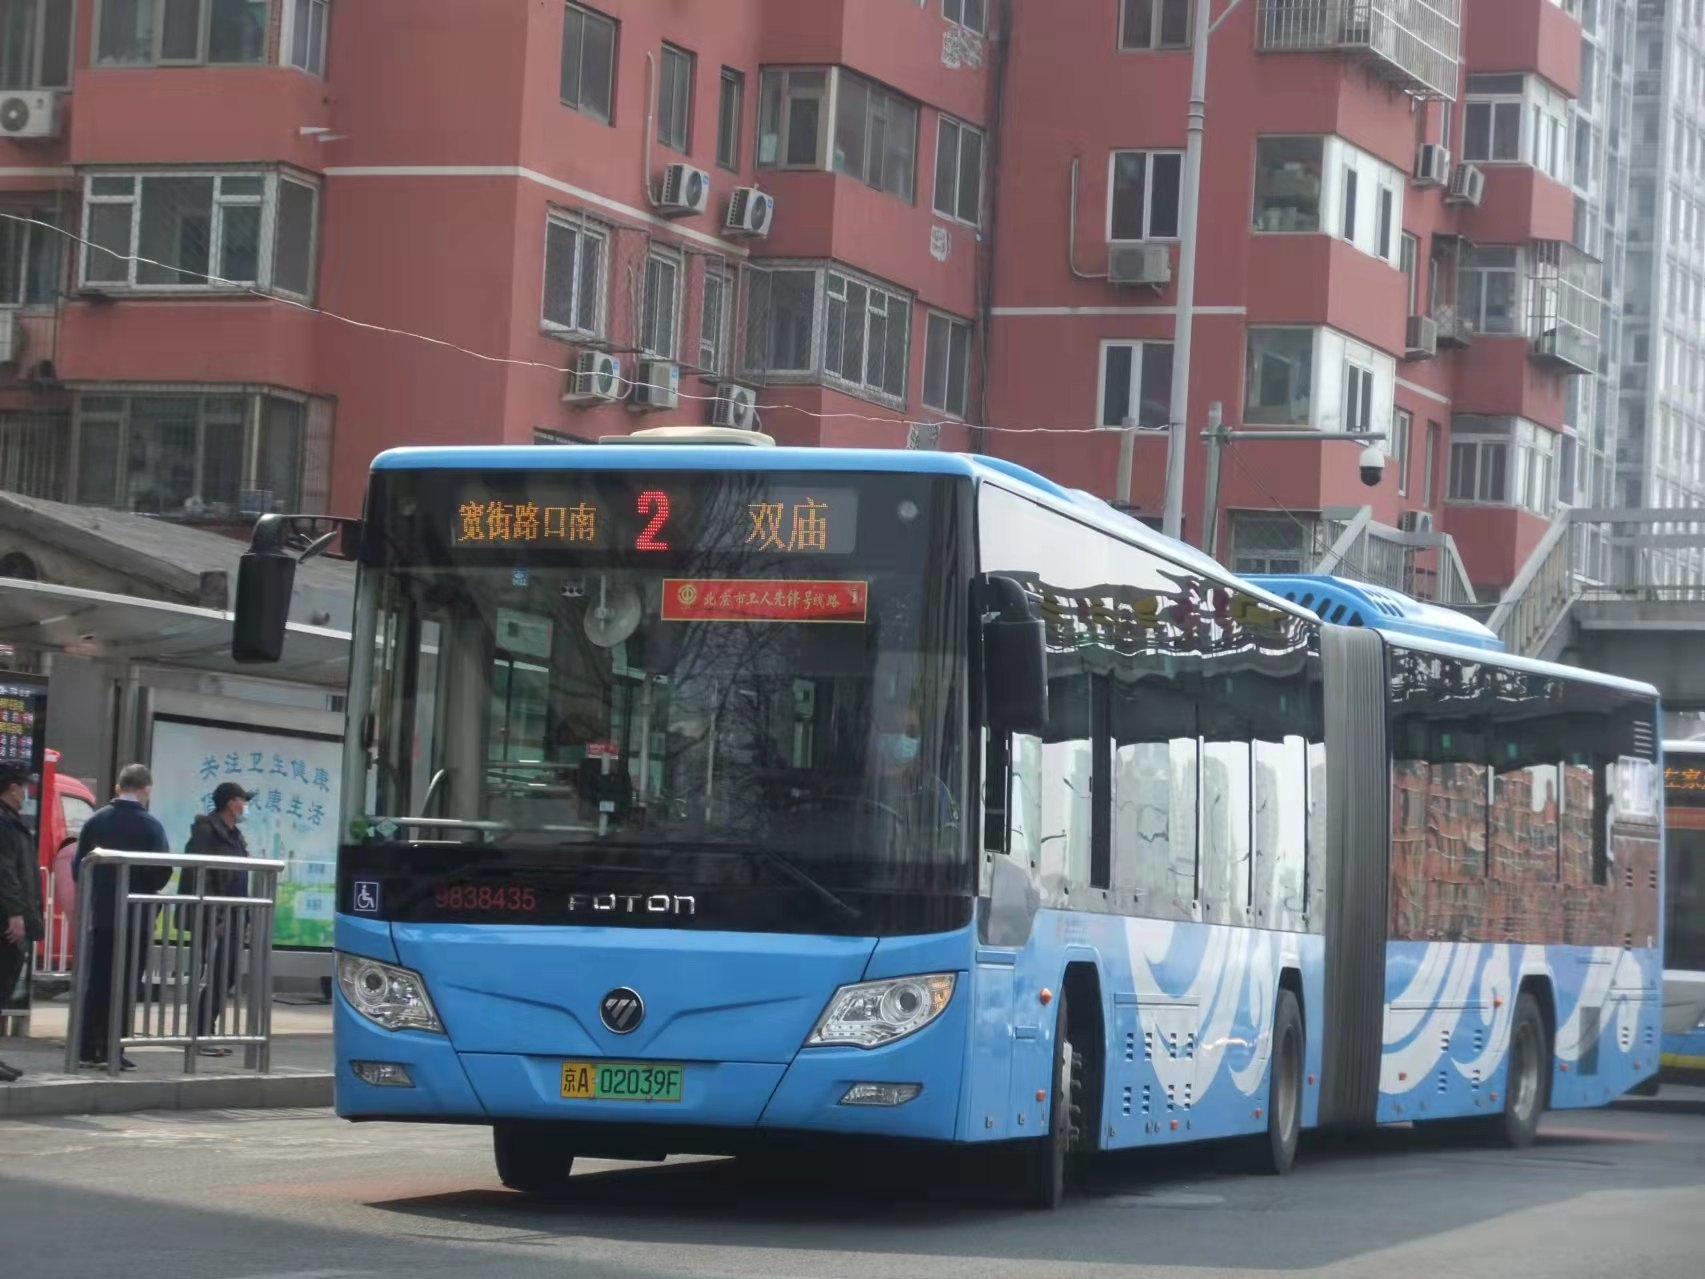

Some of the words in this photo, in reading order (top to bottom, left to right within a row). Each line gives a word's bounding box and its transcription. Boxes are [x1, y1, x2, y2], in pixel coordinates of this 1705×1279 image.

[458, 500, 597, 541] 宽街路口南
[636, 491, 669, 550] 2
[745, 497, 828, 551] 双庙
[703, 590, 840, 609] 北京市工人先锋号线路
[434, 886, 536, 911] 9838435
